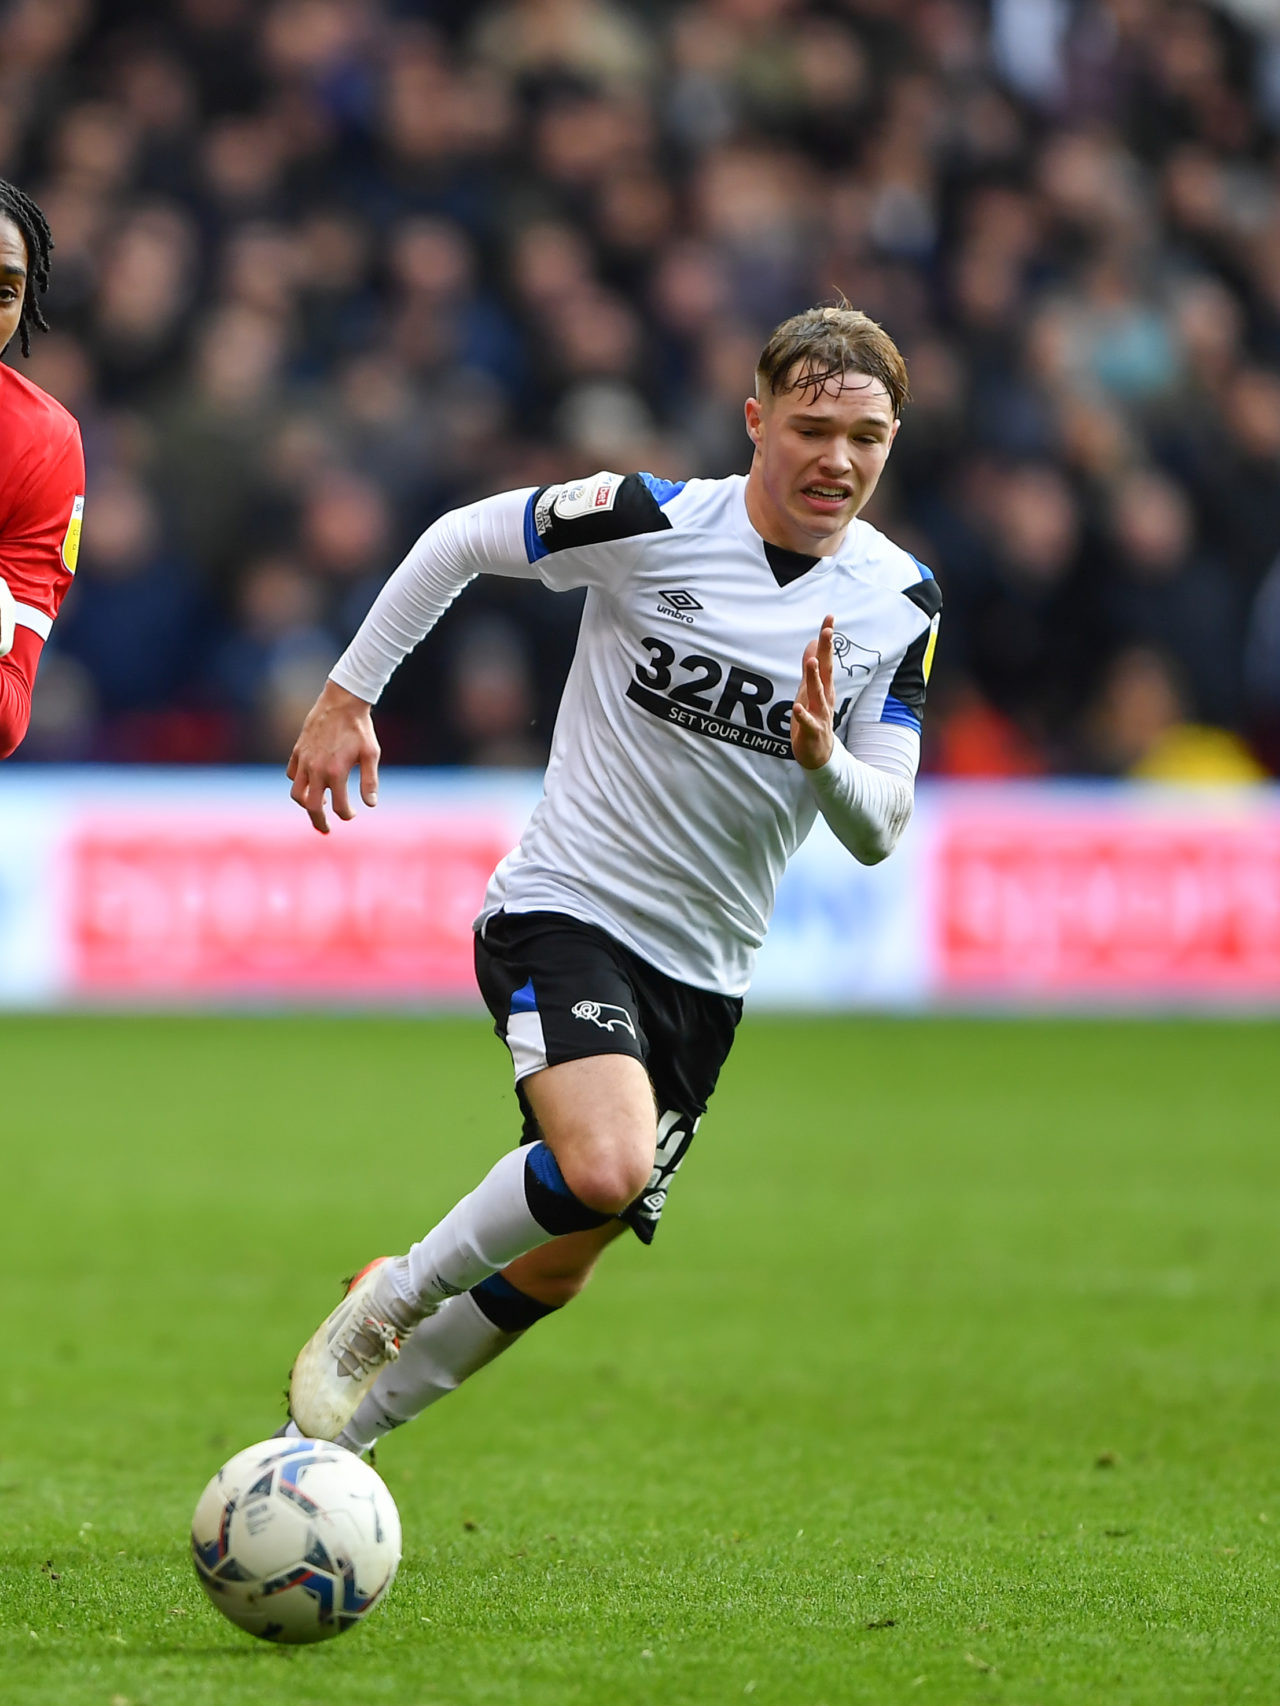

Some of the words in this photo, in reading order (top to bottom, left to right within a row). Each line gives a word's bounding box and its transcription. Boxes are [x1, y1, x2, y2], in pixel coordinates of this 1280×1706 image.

[657, 604, 694, 624] umbro
[669, 707, 697, 727] SET
[700, 718, 741, 742] YOUR
[742, 732, 789, 756] LIMITS
